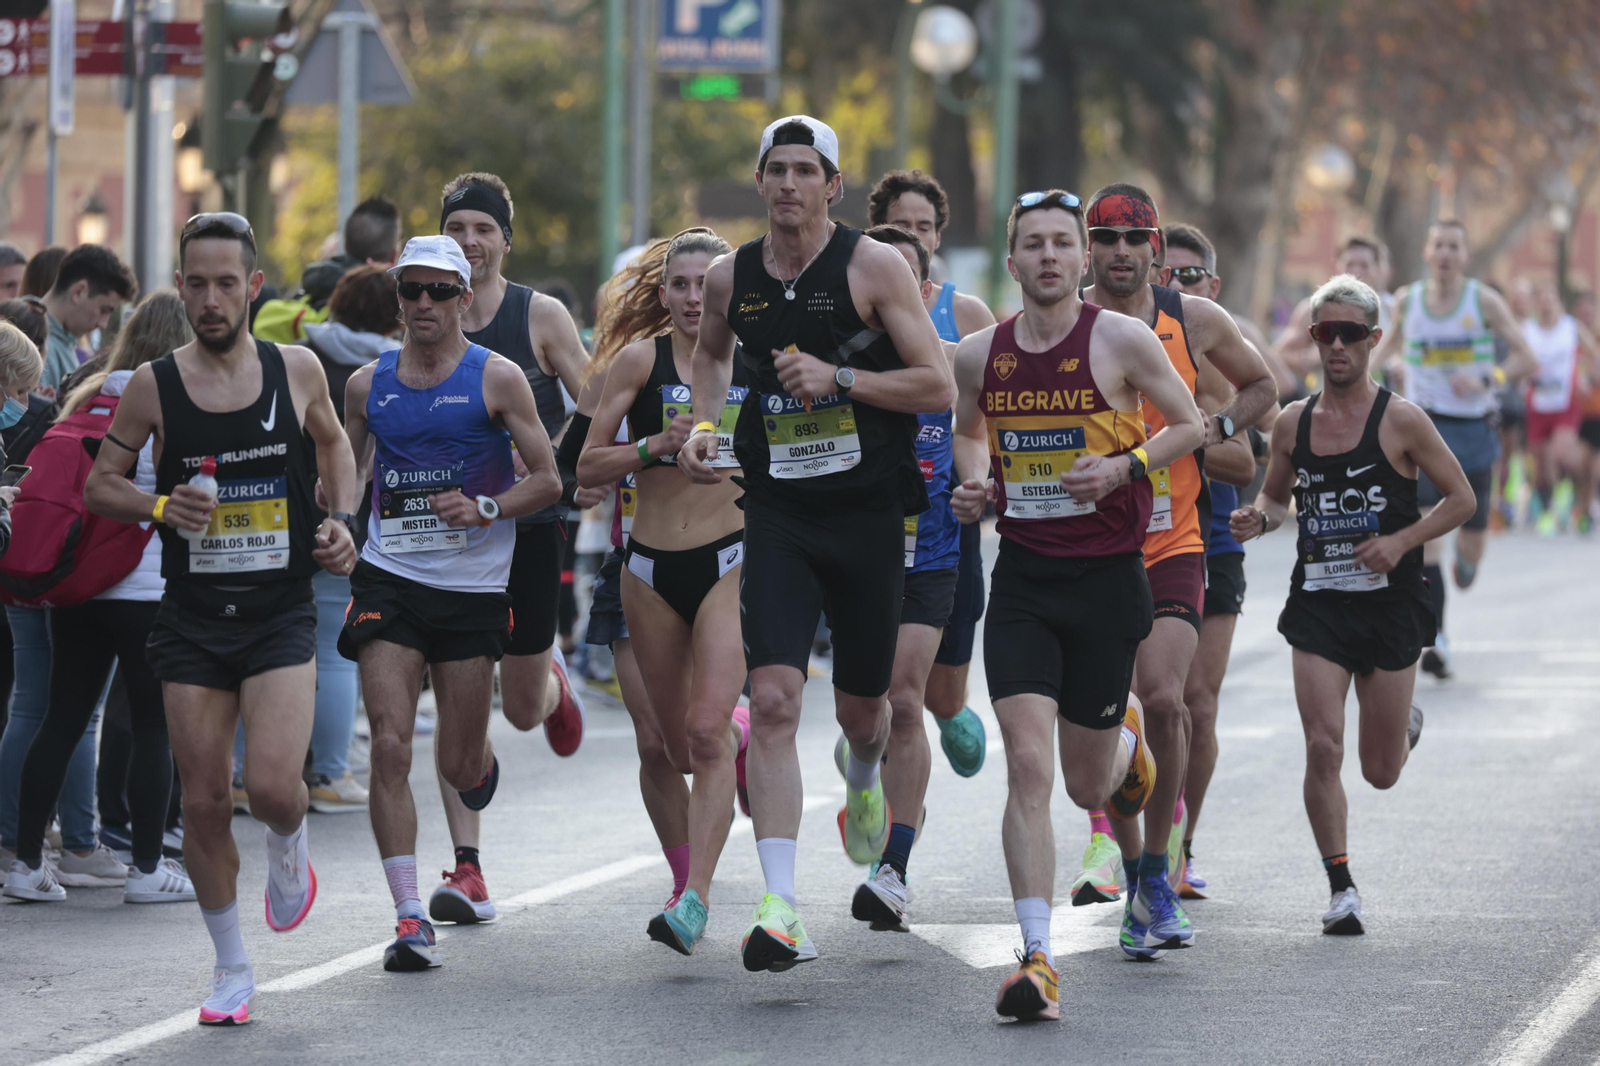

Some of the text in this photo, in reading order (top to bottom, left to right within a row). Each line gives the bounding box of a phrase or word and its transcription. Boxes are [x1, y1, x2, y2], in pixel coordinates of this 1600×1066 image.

[785, 393, 839, 409] ZUICH
[987, 389, 1095, 411] BELGRAVE
[794, 422, 819, 437] 893
[1021, 433, 1073, 448] ZURICH
[182, 443, 287, 468] TORUNNING
[789, 441, 835, 457] GONZALO
[401, 470, 451, 484] ZURICH
[1029, 462, 1052, 477] 510
[1311, 474, 1324, 483] NN
[218, 483, 274, 498] ZURICH
[404, 497, 430, 512] 2631
[224, 514, 250, 528] 535
[402, 518, 437, 530] MISTER
[1321, 516, 1368, 531] ZURICH
[201, 535, 275, 550] CARLOS ROJO
[1324, 542, 1354, 557] 2548
